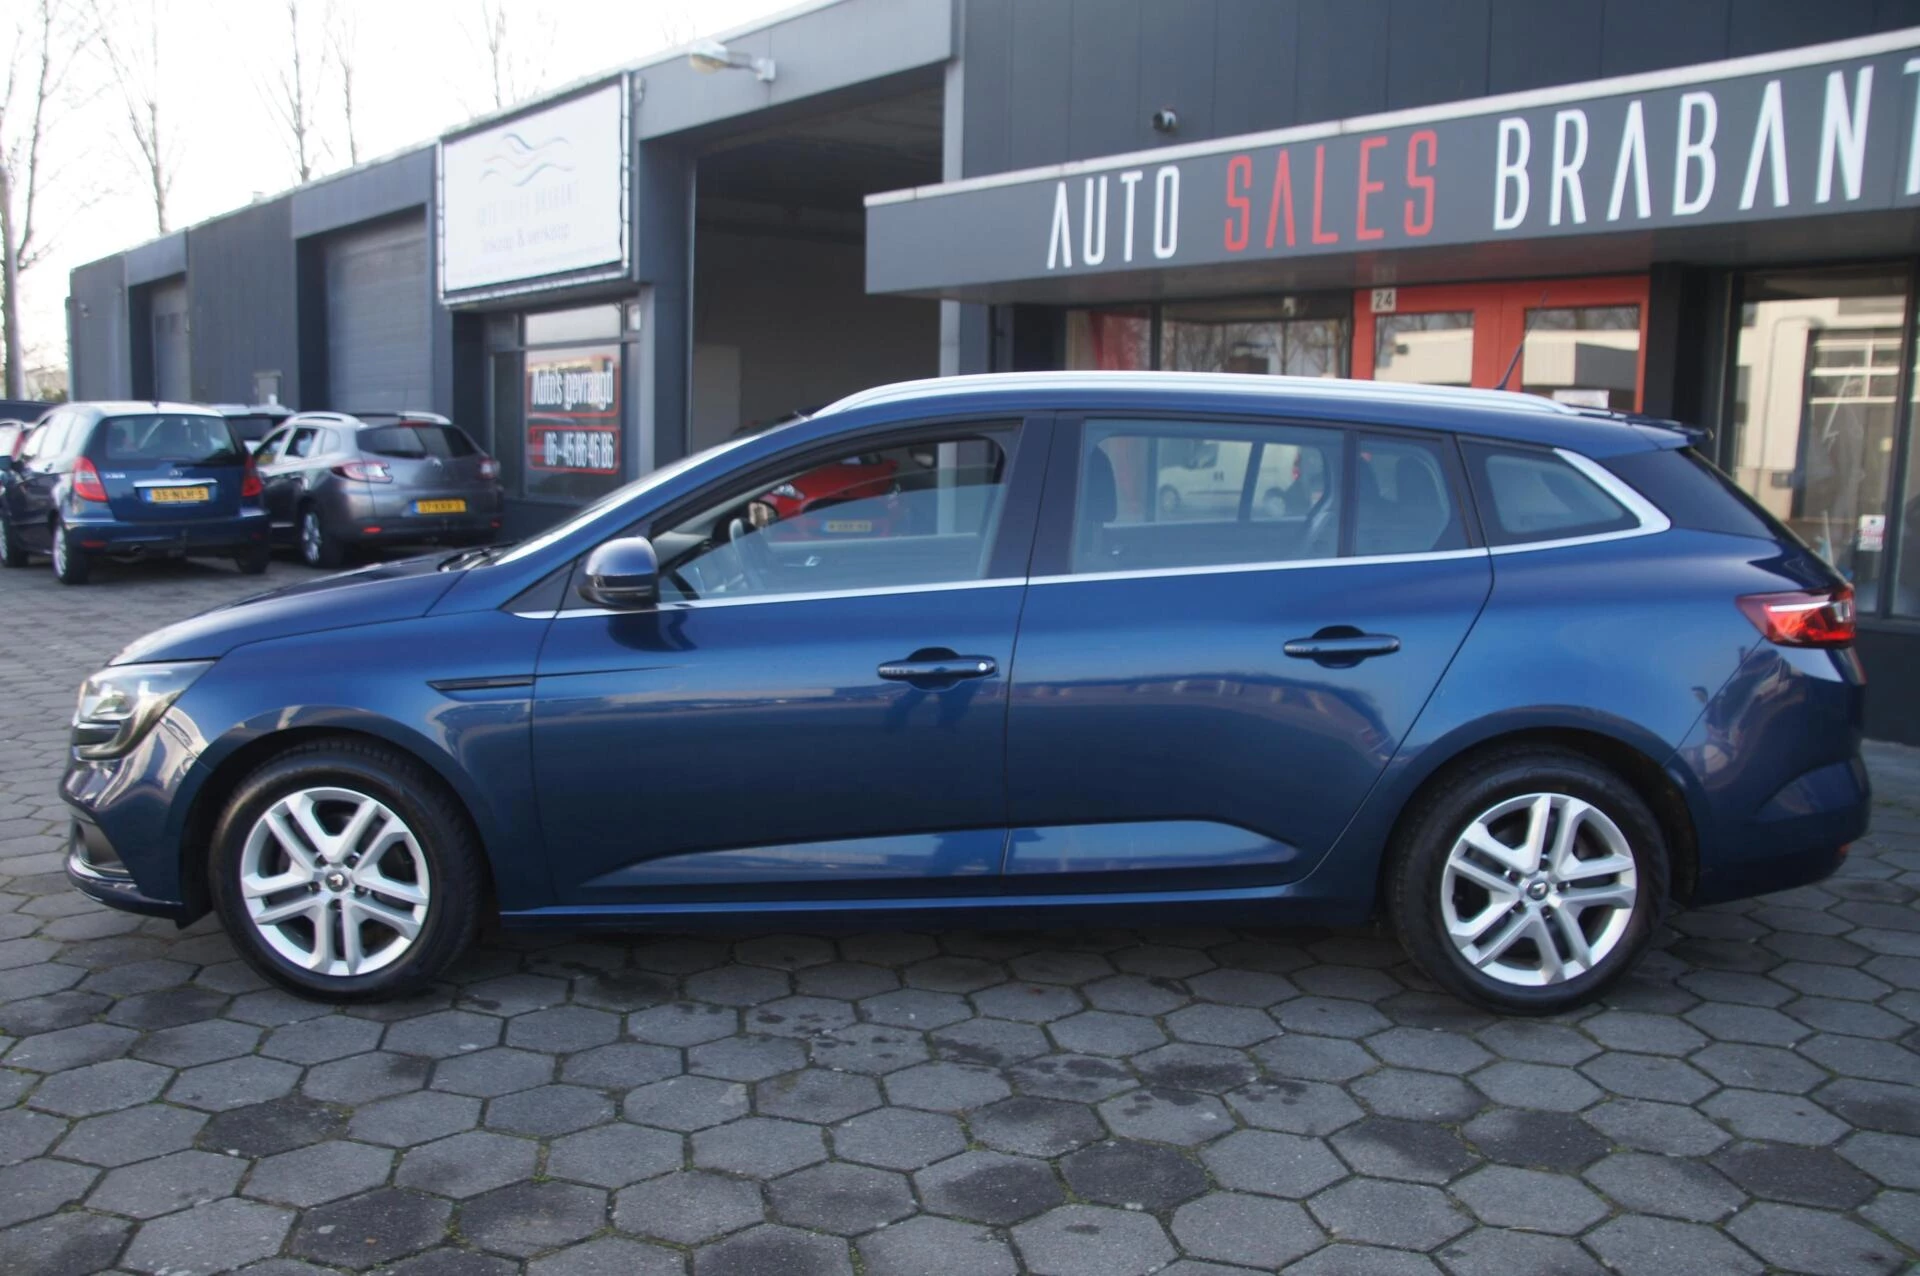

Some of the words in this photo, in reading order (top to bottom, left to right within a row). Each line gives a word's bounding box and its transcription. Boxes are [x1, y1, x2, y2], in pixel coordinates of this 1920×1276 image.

[1047, 165, 1180, 269] AUTO
[1225, 130, 1437, 252] SALES
[1374, 291, 1393, 310] 24
[532, 366, 562, 405] Auto's
[564, 360, 614, 411] gevraagd
